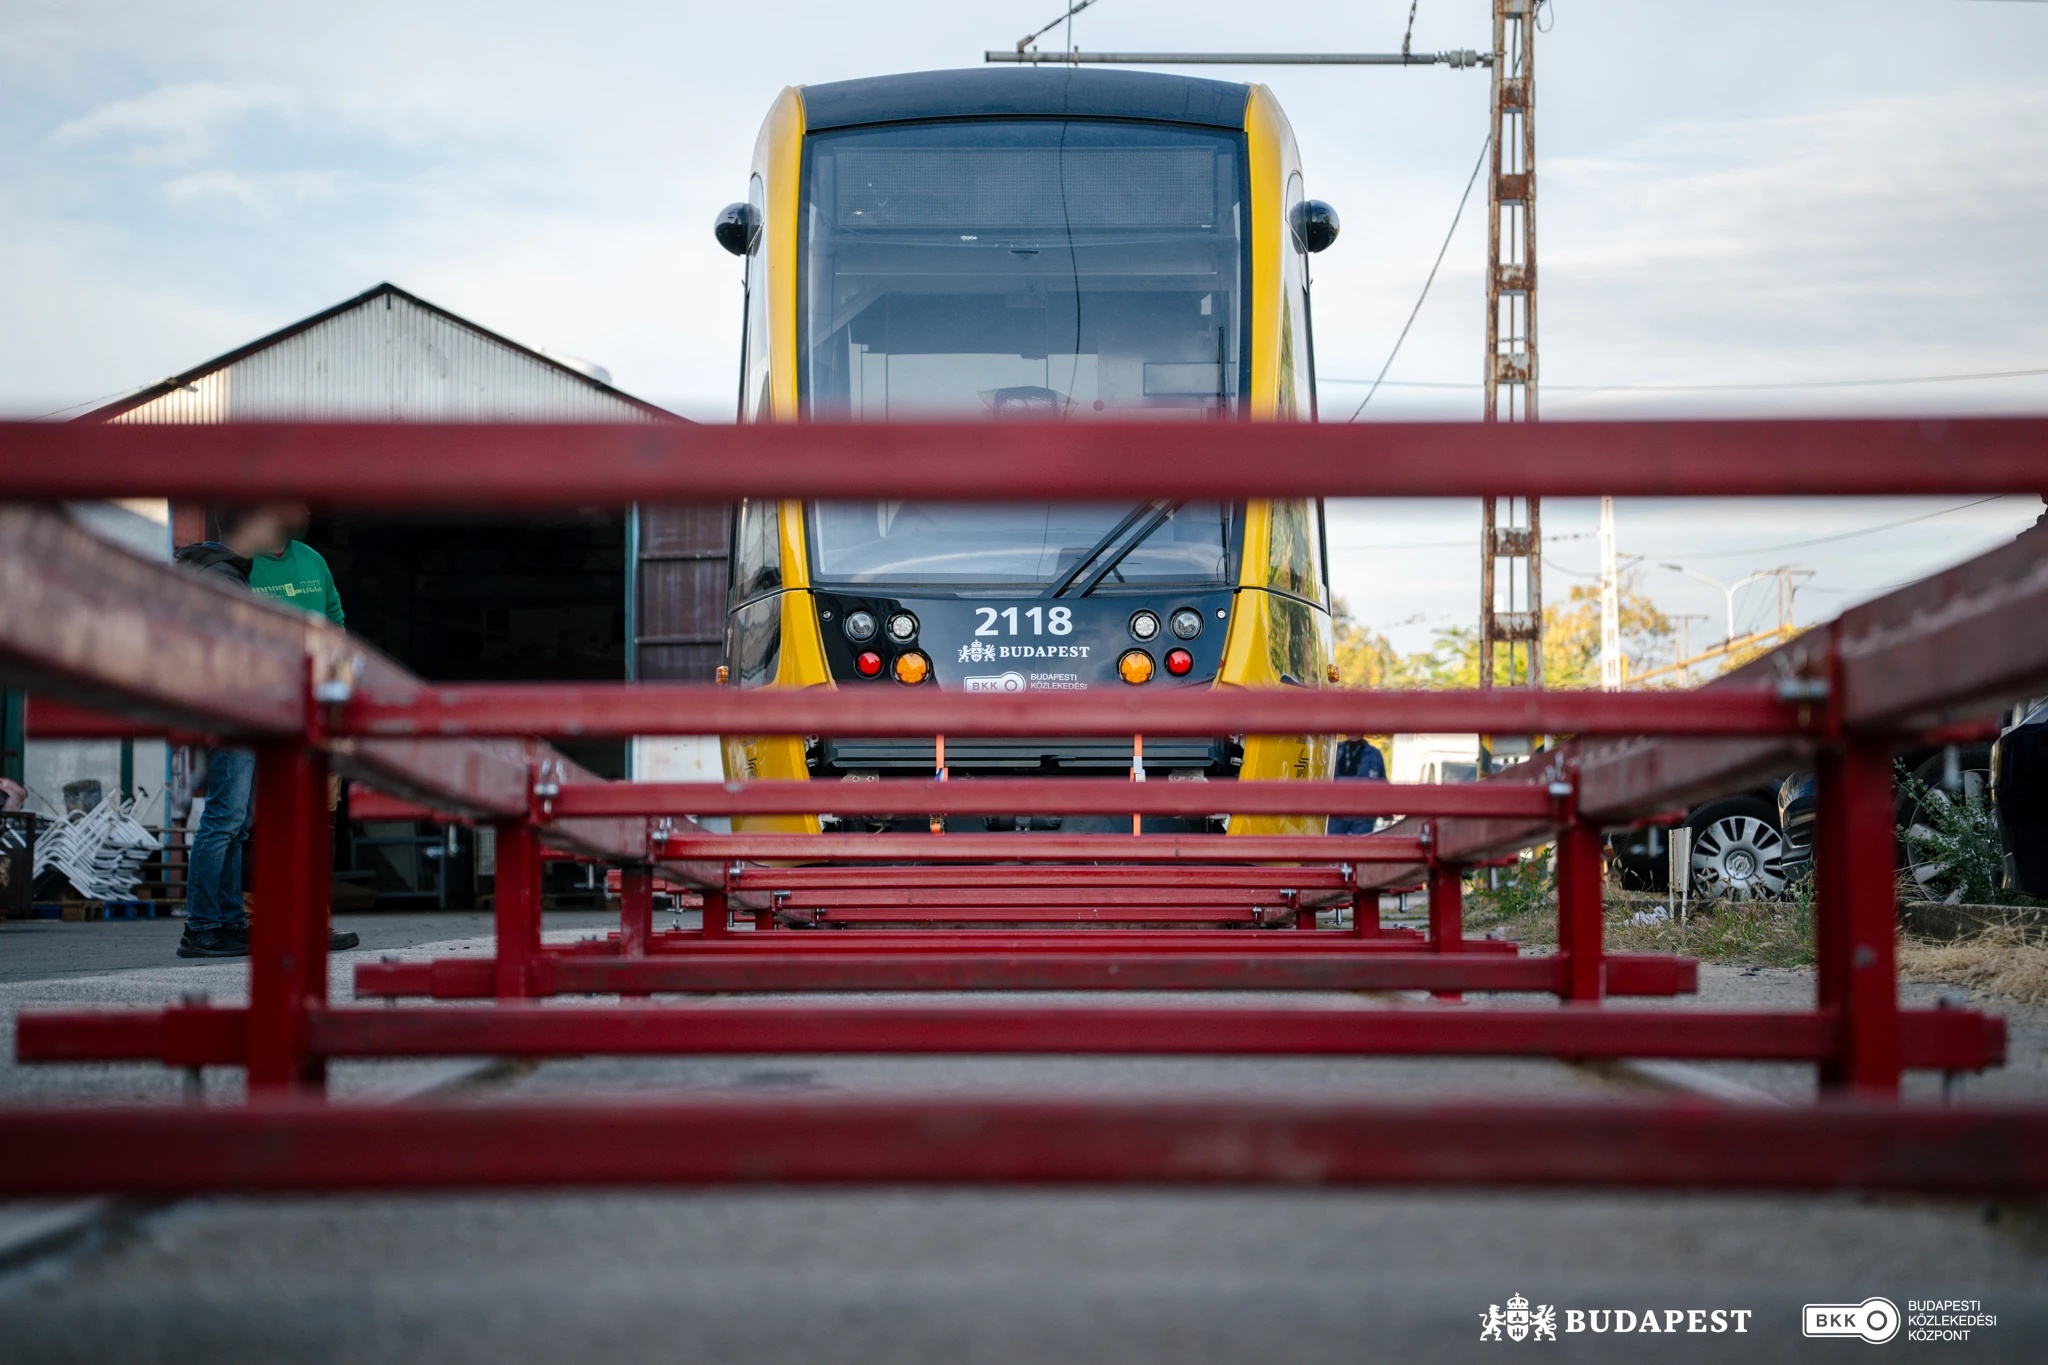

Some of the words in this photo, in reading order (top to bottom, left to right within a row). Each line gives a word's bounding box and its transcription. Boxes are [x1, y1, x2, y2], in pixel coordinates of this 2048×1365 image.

[974, 606, 1073, 636] 2118
[999, 646, 1090, 658] BUDAPEST
[1030, 673, 1077, 682] BUDAPESTI
[972, 681, 998, 691] BKK
